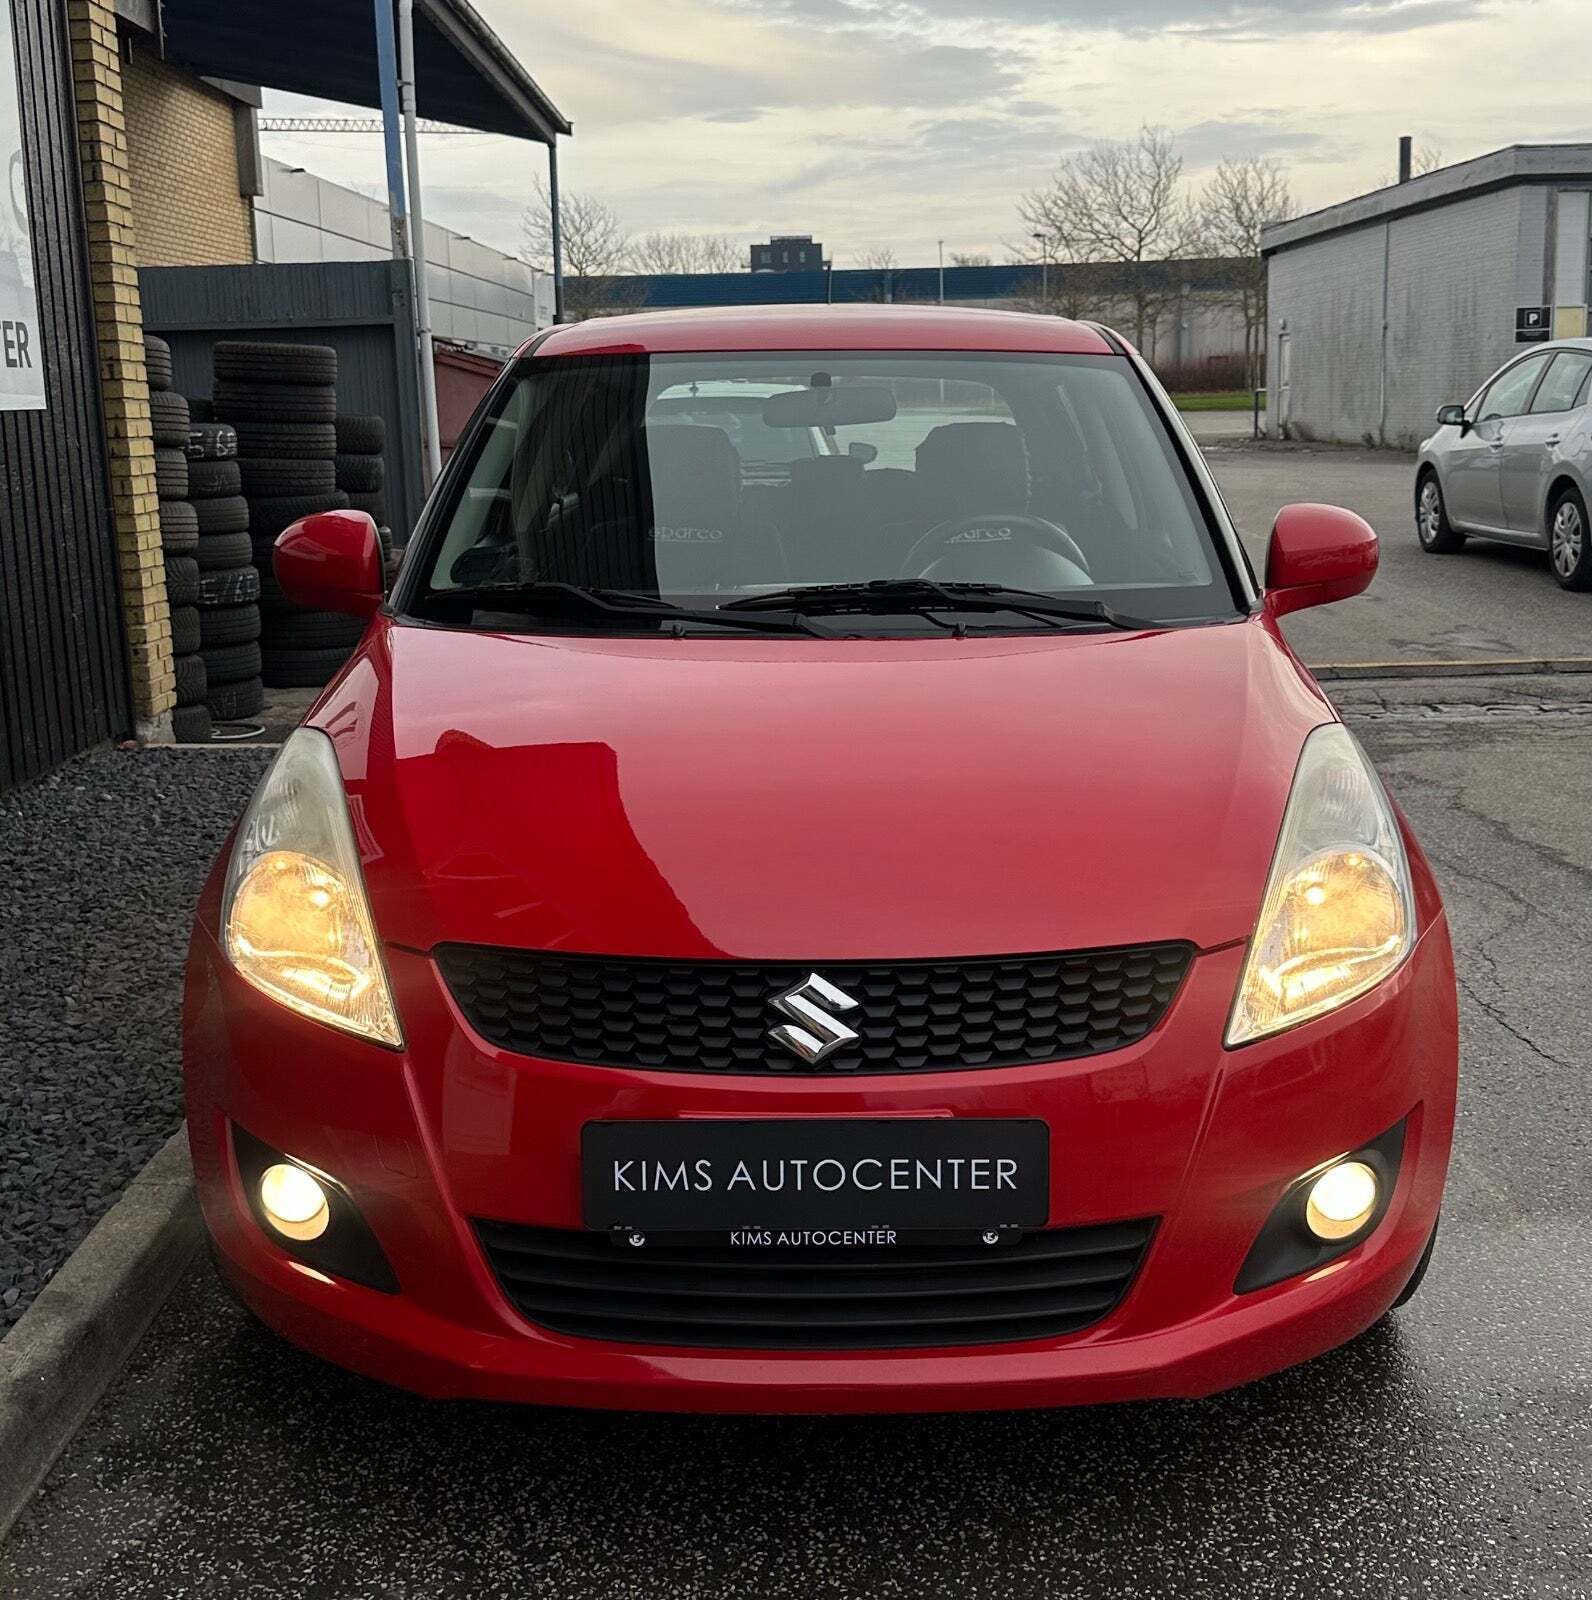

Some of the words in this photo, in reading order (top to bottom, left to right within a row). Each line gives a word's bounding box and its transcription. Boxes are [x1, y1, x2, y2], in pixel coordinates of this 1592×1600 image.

[1529, 313, 1538, 325] P
[0, 320, 32, 369] ER
[613, 1160, 713, 1193] KIMS
[727, 1158, 1018, 1192] AUTOCENTER
[730, 1231, 772, 1246] KIMS
[777, 1231, 897, 1246] AUTOCENTER
